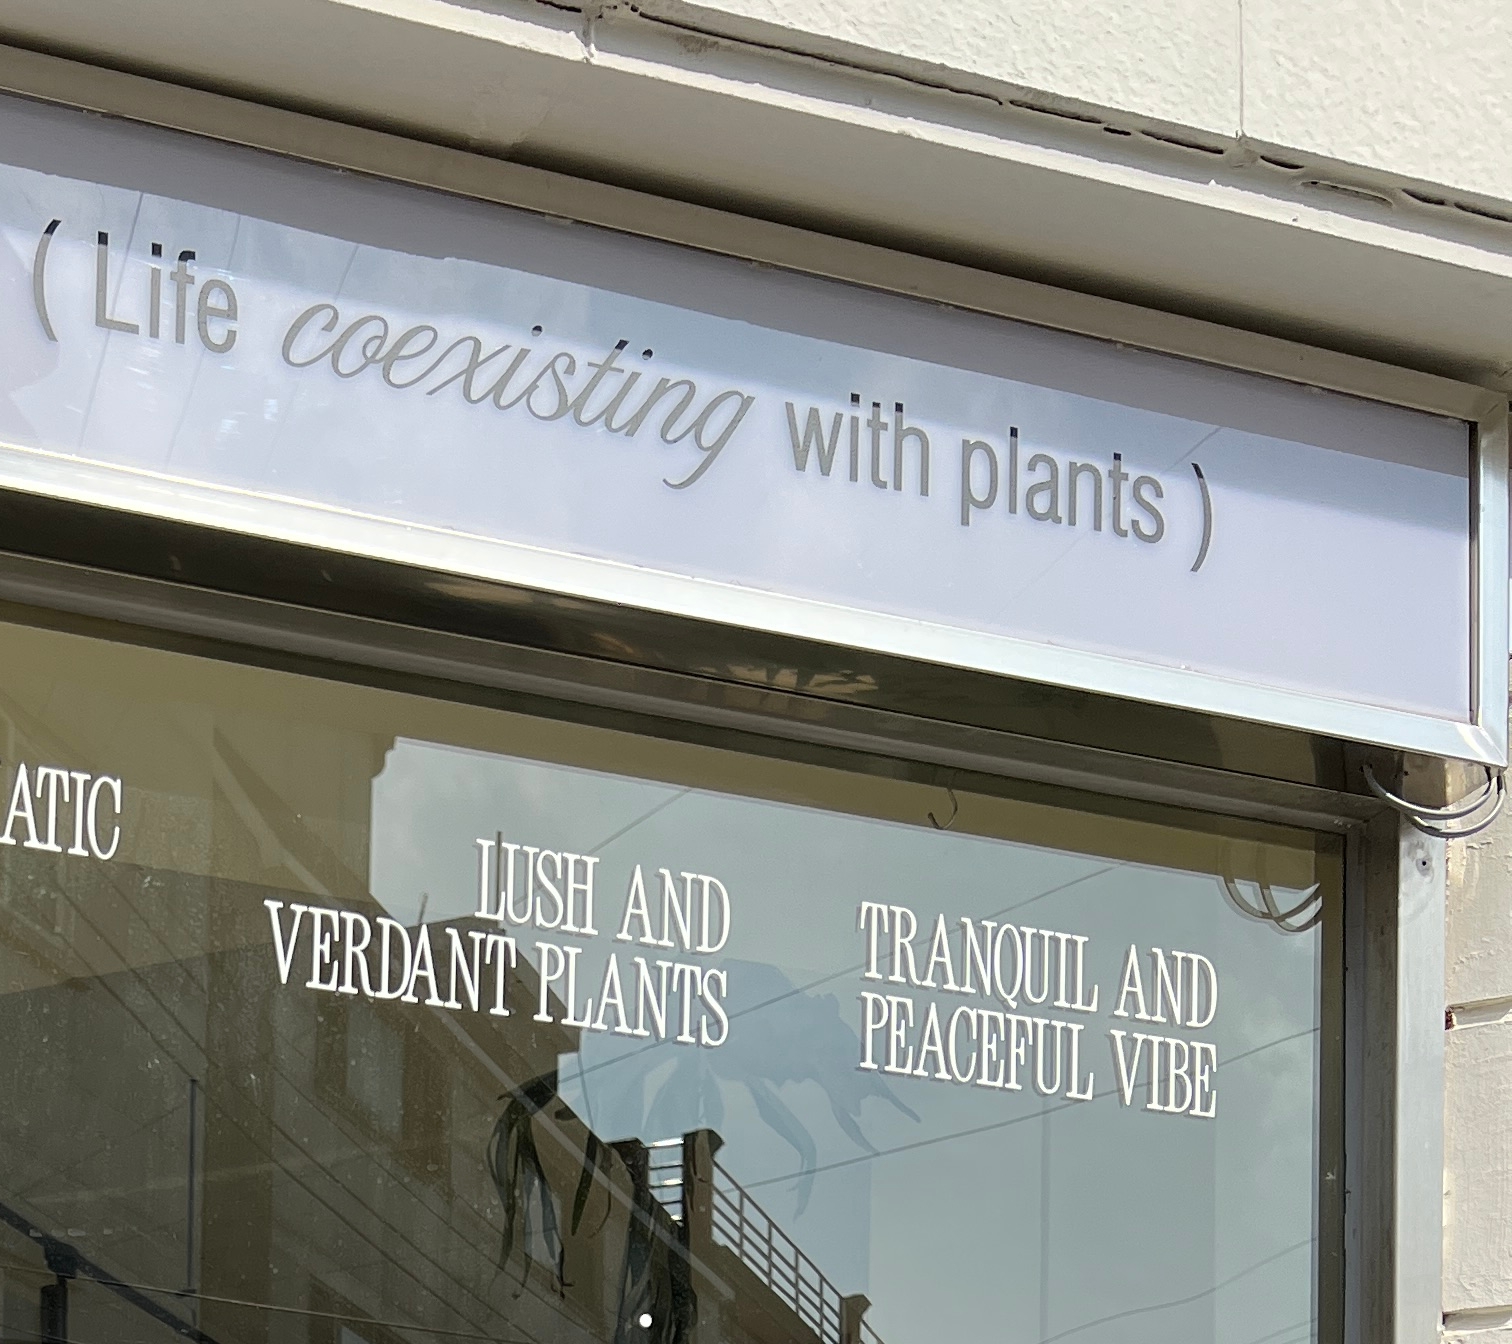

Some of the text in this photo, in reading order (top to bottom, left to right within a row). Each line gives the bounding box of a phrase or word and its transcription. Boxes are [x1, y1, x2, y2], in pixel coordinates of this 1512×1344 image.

[95, 230, 239, 353] Life
[282, 294, 756, 489] coexisting
[786, 391, 932, 496] with
[961, 426, 1165, 544] plants
[475, 838, 731, 953] LUSH AND
[264, 899, 729, 1046] VERDANT PLANTS
[860, 901, 1218, 1028] TRANQUIL AND
[859, 992, 1217, 1118] PEACEFUL VIBE
